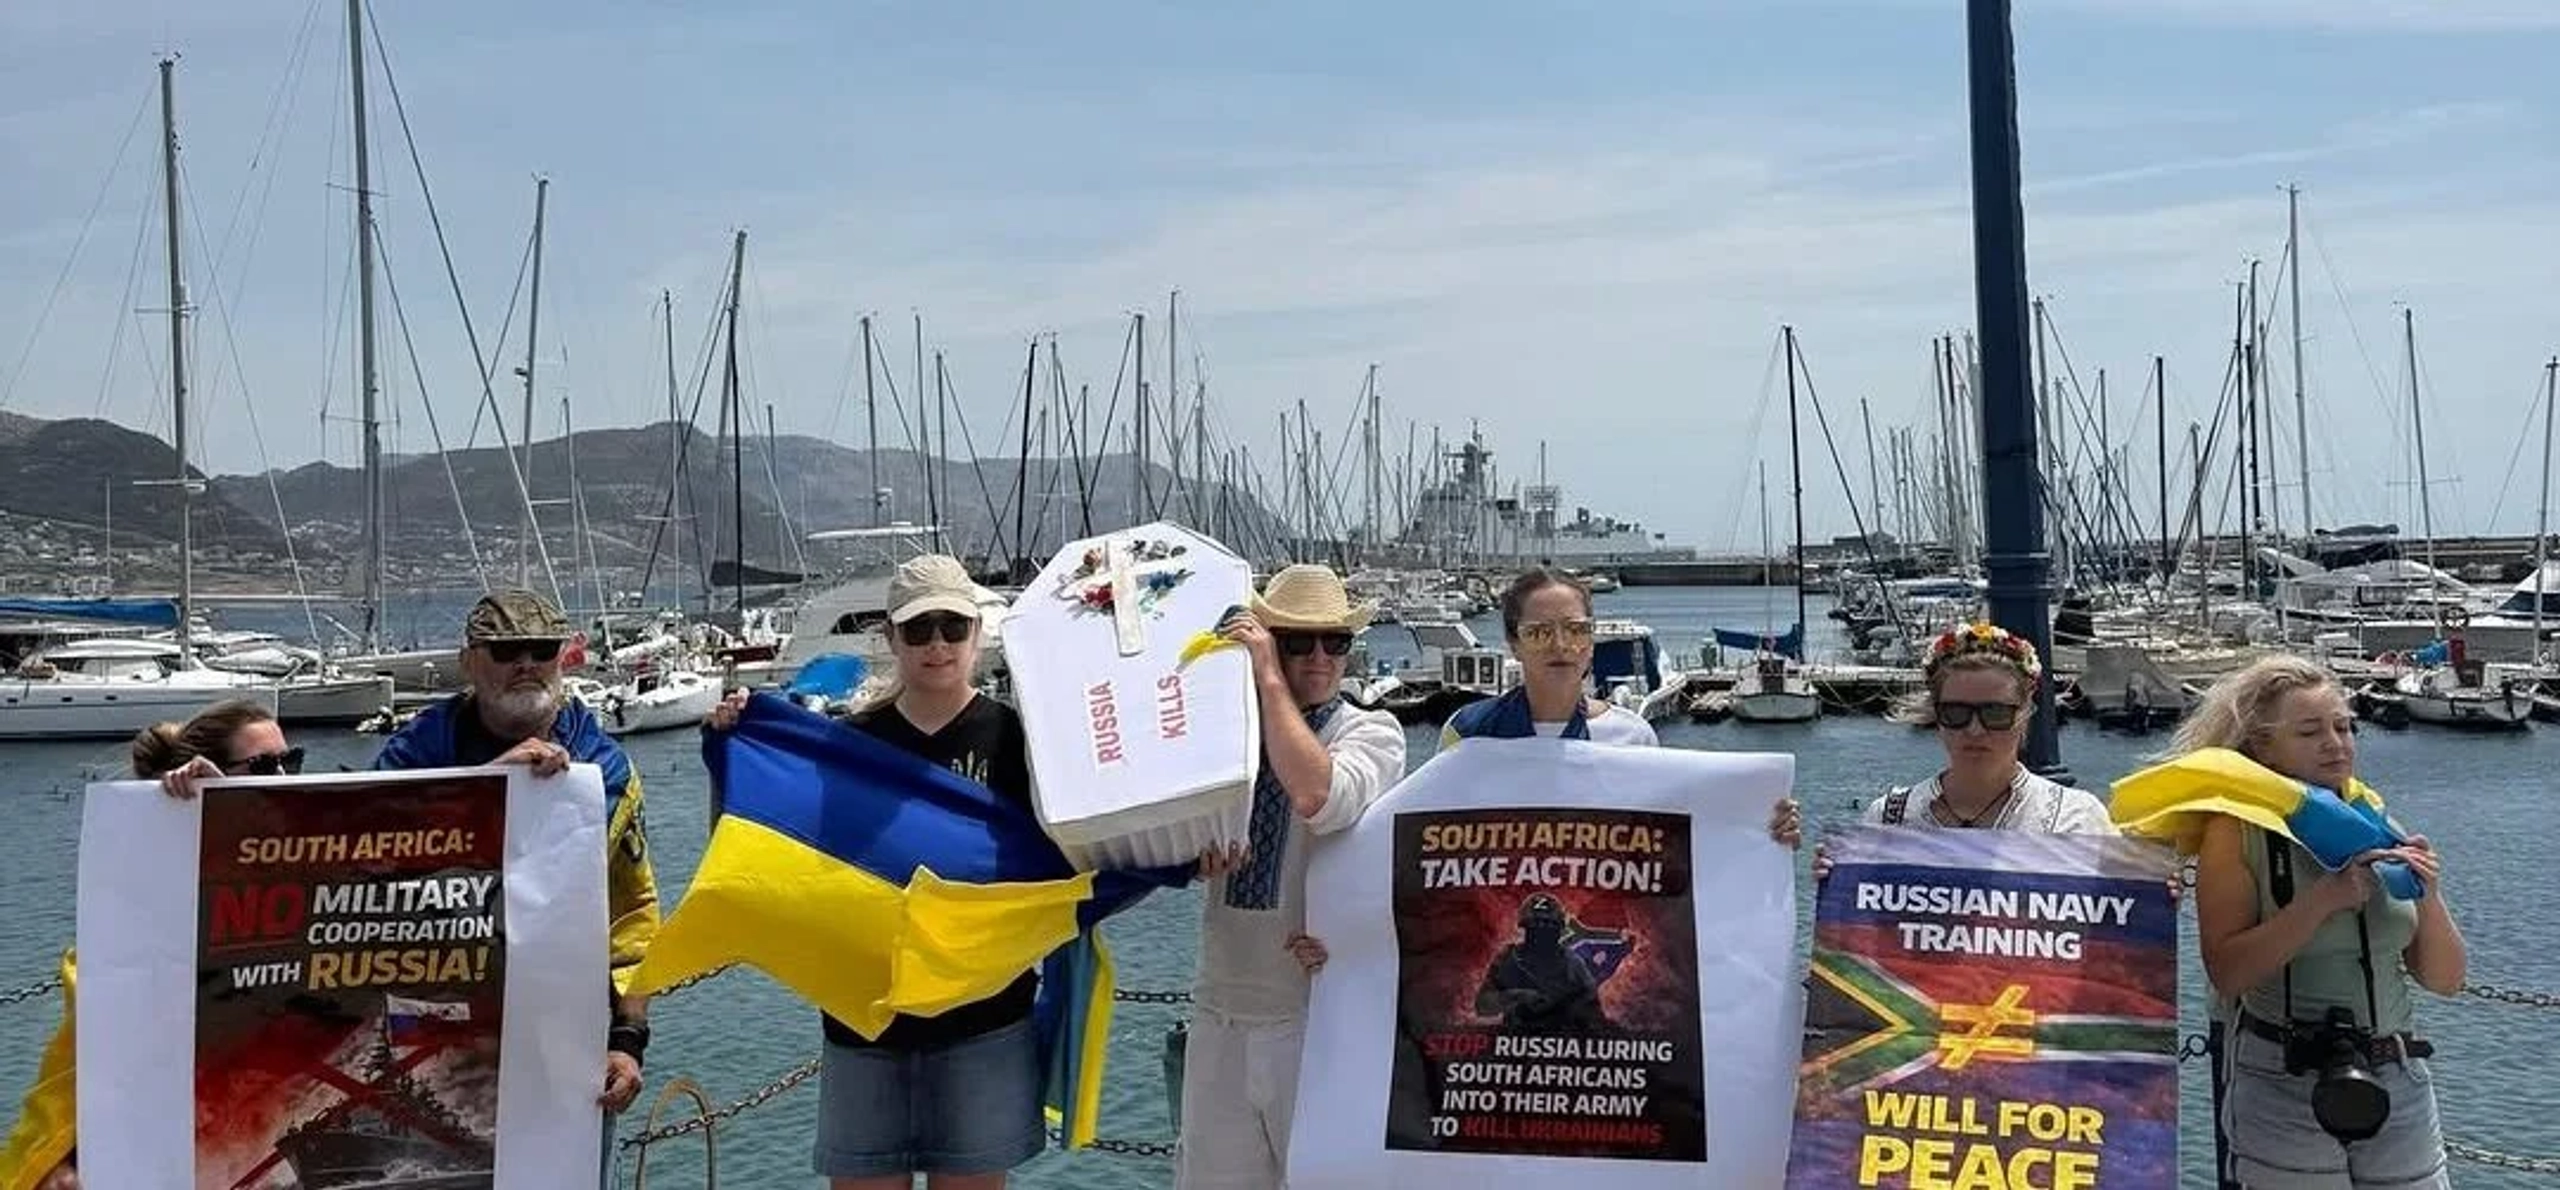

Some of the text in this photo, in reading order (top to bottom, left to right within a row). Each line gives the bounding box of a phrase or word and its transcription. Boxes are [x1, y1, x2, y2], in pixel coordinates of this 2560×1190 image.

[1089, 680, 1122, 764] RUSSIA
[1157, 674, 1187, 739] KILLS
[237, 828, 475, 864] SOUTH AFRICA:
[1422, 822, 1664, 852] SOUTH AFRICA:
[1421, 856, 1664, 892] TAKE ACTION!
[209, 876, 494, 944] NO MILITARY
[1856, 882, 2135, 926] RUSSIAN NAVY
[307, 915, 495, 945] COOPERATION
[1898, 922, 2082, 960] TRAINING
[232, 946, 490, 990] WITH RUSSIA!
[1424, 1034, 1673, 1062] STOP RUSSIA LURING
[1446, 1062, 1647, 1089] SOUTH AFRICANS
[1442, 1090, 1648, 1118] INTO THEIR ARMY
[1864, 1090, 2105, 1144] WILL FOR
[1430, 1116, 1664, 1145] TO KILL UKRAINIANS
[1859, 1134, 2100, 1190] PEACE
